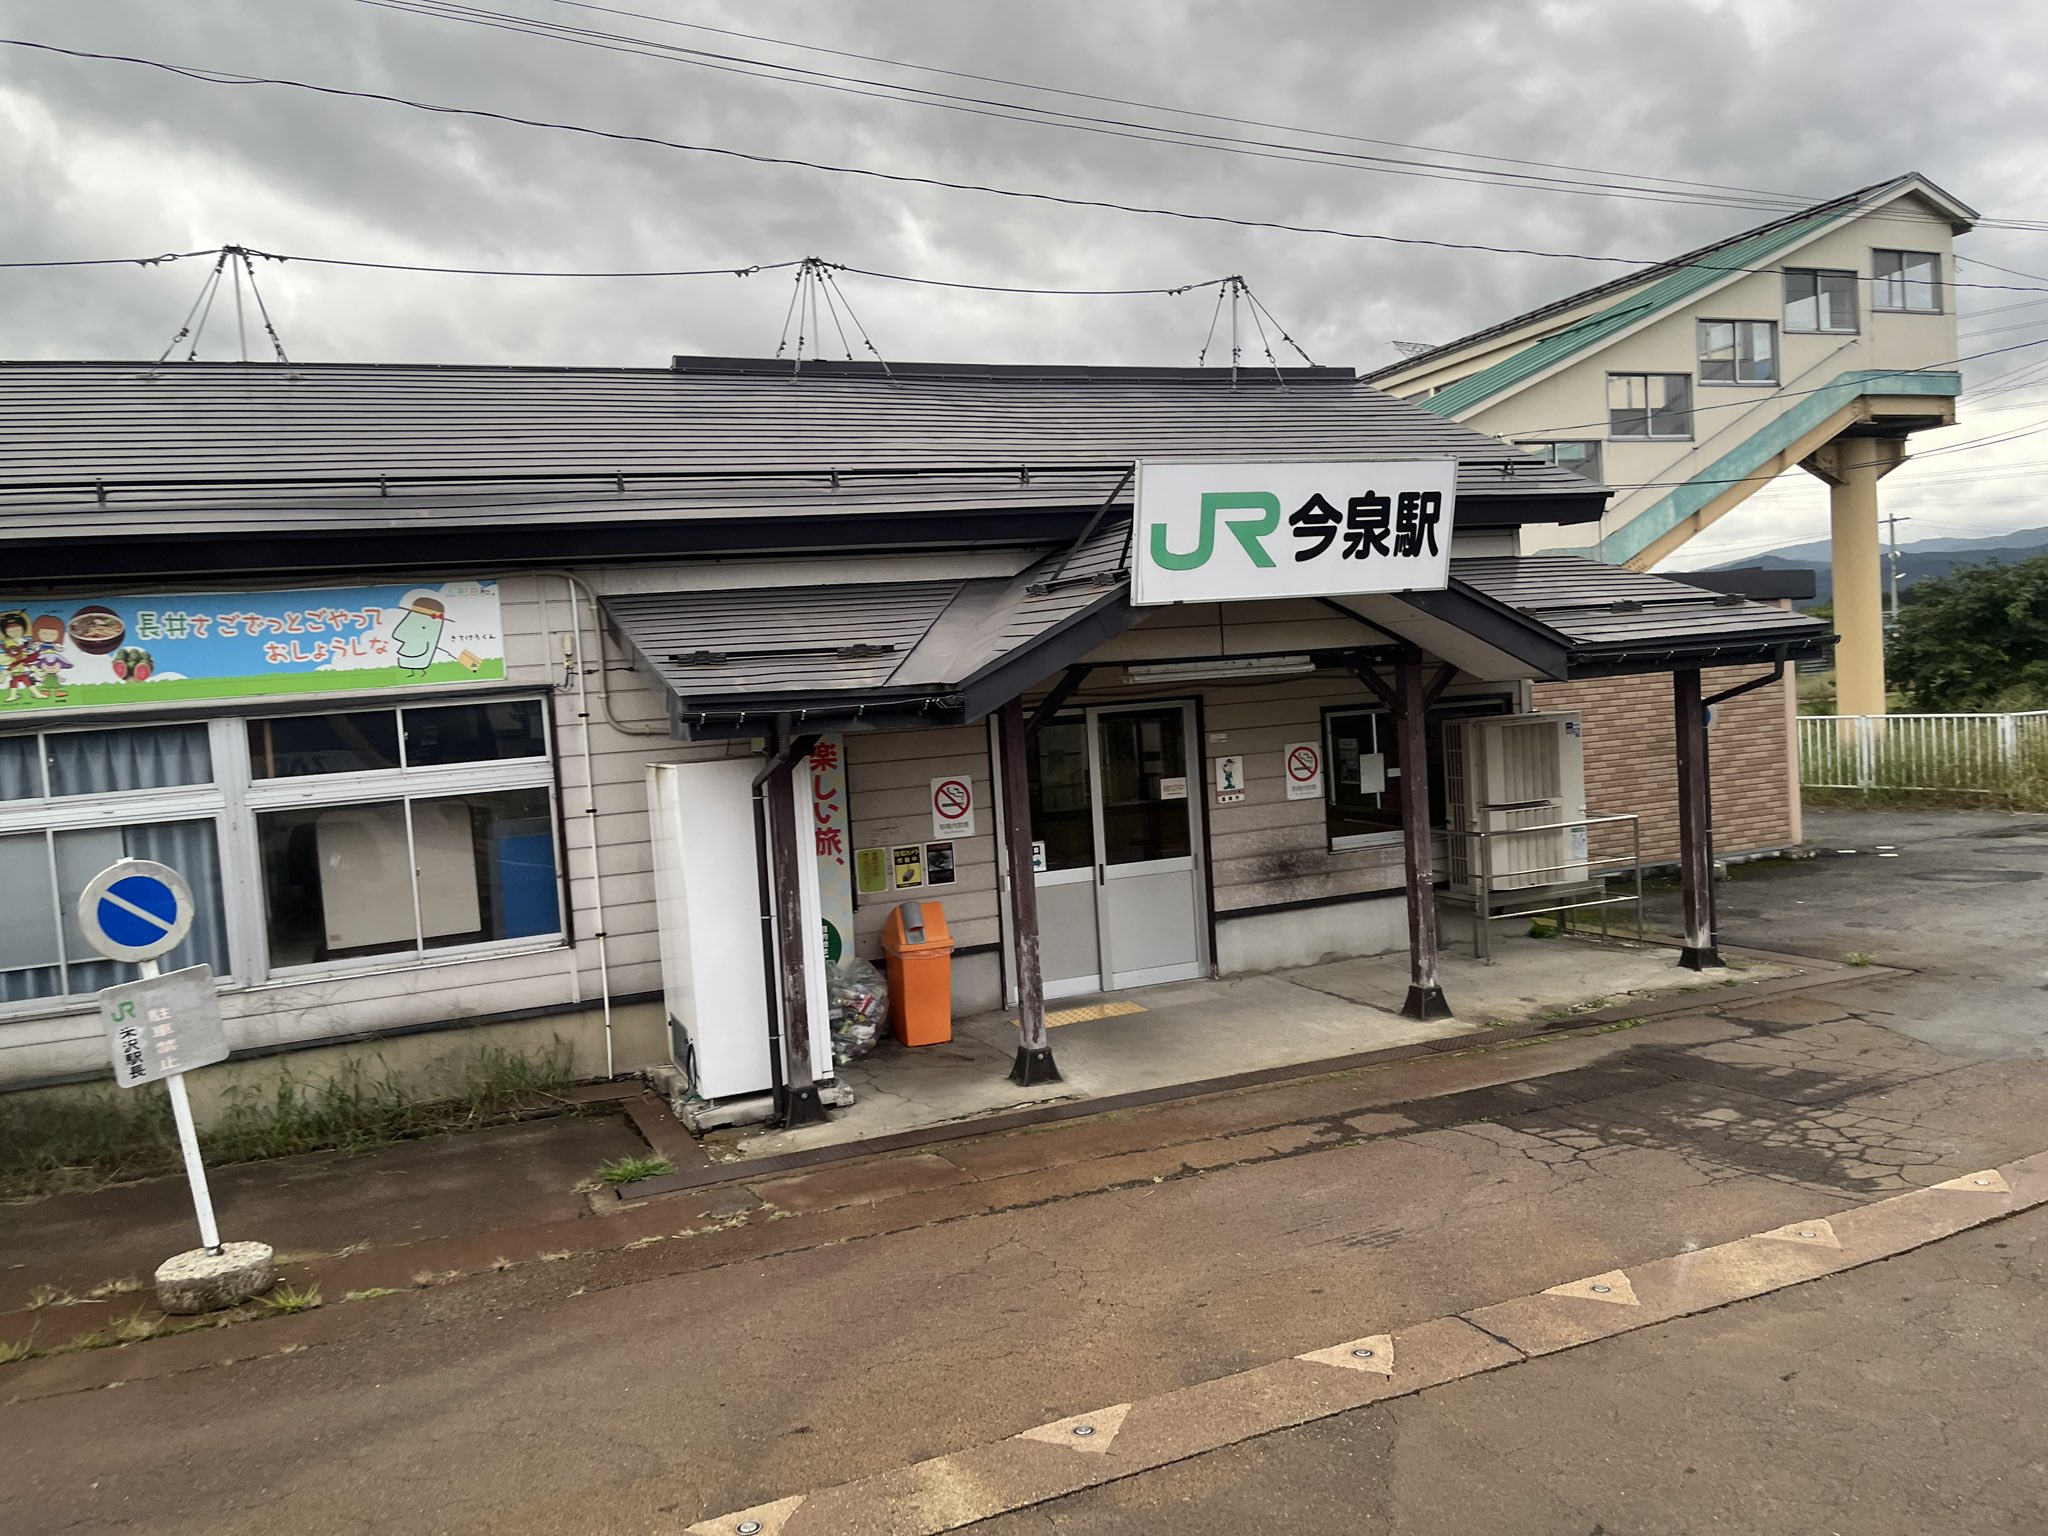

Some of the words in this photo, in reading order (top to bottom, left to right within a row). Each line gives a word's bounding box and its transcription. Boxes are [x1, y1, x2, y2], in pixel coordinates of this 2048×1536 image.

[1151, 491, 1281, 571] JR
[1288, 490, 1442, 562] 今泉駅
[266, 637, 389, 662] おしょうしな
[111, 1000, 136, 1023] JR
[148, 1007, 182, 1071] 駐車禁止
[119, 1025, 147, 1080] 米沢駅長
